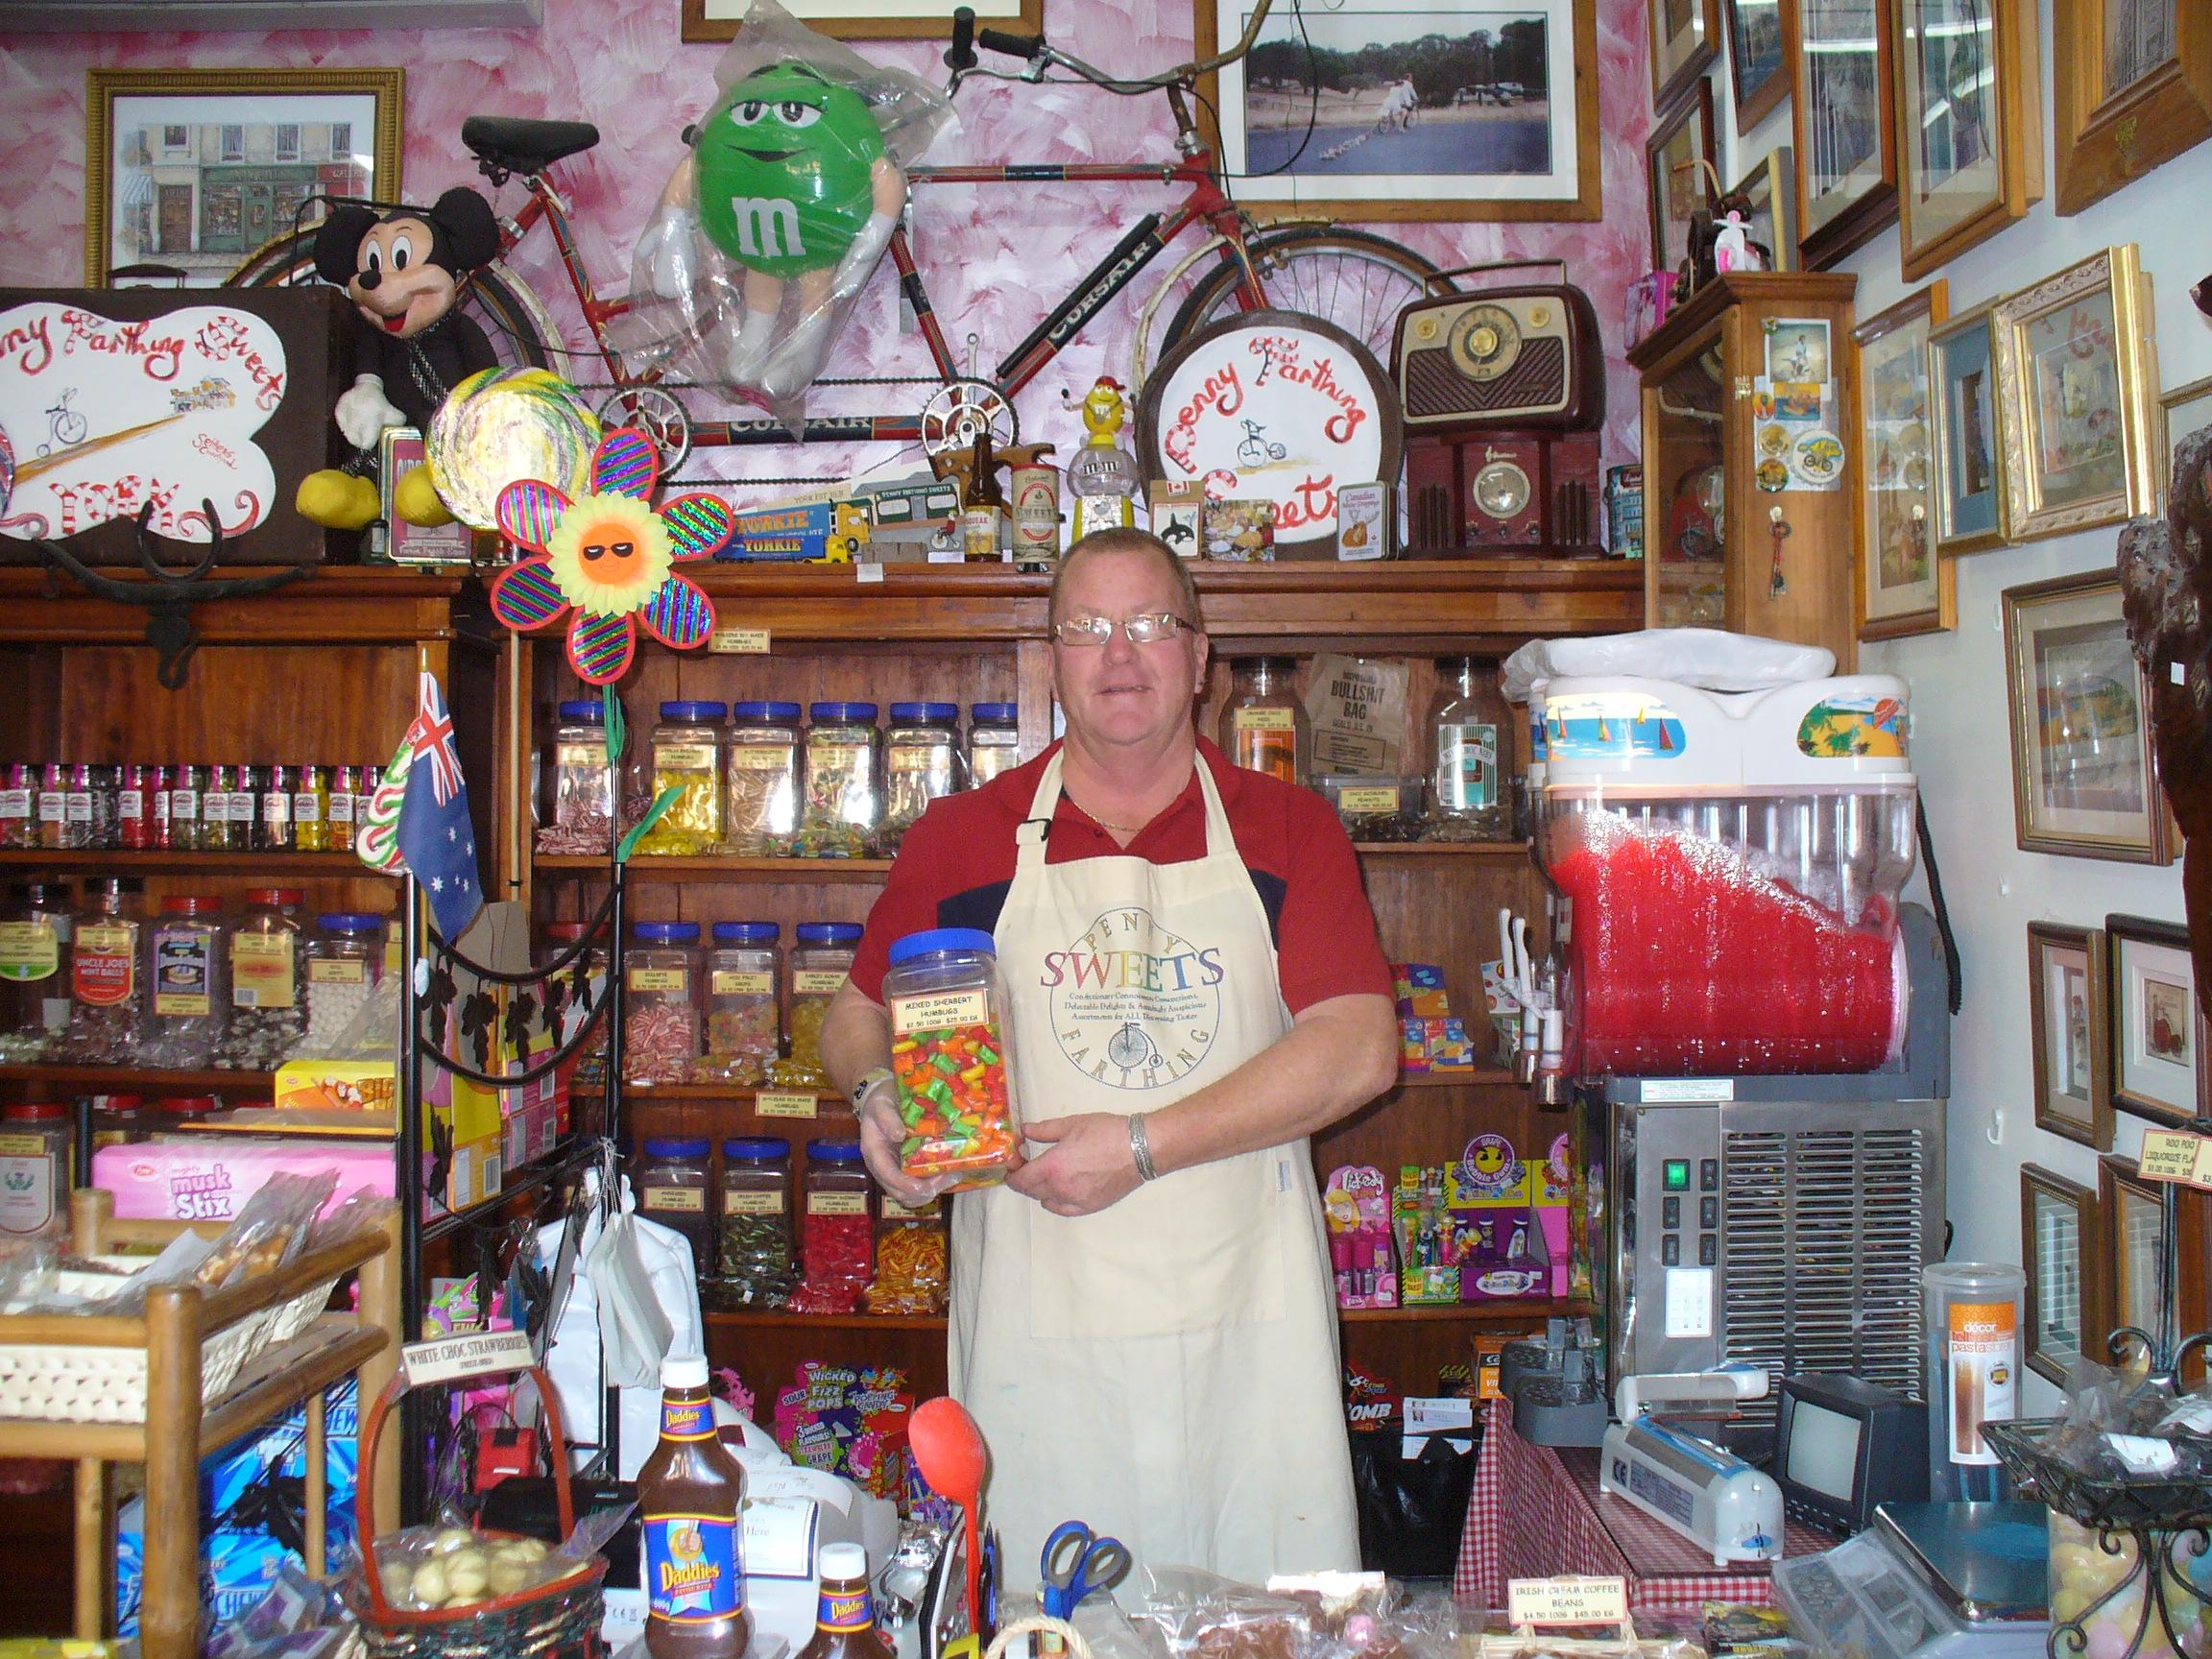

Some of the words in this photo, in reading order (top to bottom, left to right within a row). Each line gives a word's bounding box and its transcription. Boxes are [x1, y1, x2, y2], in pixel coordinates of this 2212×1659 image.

[60, 310, 185, 381] Farthing
[195, 316, 285, 411] Sweets
[1164, 362, 1245, 474] Penny
[1249, 336, 1367, 444] Farthing
[49, 474, 180, 538] YORK
[744, 538, 802, 553] YORKIE
[1331, 679, 1386, 705] BULLSHIT
[1343, 701, 1368, 720] BAG
[1085, 912, 1181, 954] PENNY
[80, 969, 101, 977] MINT
[101, 968, 126, 977] BALLS
[1040, 947, 1225, 993] SWEETS
[905, 1001, 931, 1011] MIXED
[933, 996, 974, 1007] SHERBERT
[921, 1007, 959, 1018] HUMBUGS
[1100, 1002, 1126, 1011] Delights
[1061, 1028, 1211, 1089] FARTHING
[1480, 1137, 1503, 1147] GRAPE
[170, 1164, 232, 1195] musk
[175, 1190, 232, 1219] Stix
[407, 1347, 442, 1365] WHITE
[442, 1344, 469, 1360] CHOC
[468, 1335, 528, 1357] STRAWBERRIES
[808, 1370, 857, 1382] WICKED
[782, 1389, 807, 1407] SOUR
[812, 1385, 840, 1398] FIZZ
[806, 1398, 844, 1410] POPS
[665, 1407, 701, 1429] Daddies
[796, 1425, 805, 1439] 3
[807, 1452, 834, 1465] GRAPE
[660, 1560, 721, 1593] Daddies
[1515, 1586, 1545, 1596] IRISH
[1548, 1585, 1580, 1595] CREAM
[1583, 1584, 1620, 1594] COFFEE
[831, 1600, 865, 1622] Daddies
[1551, 1599, 1585, 1608] BEANS
